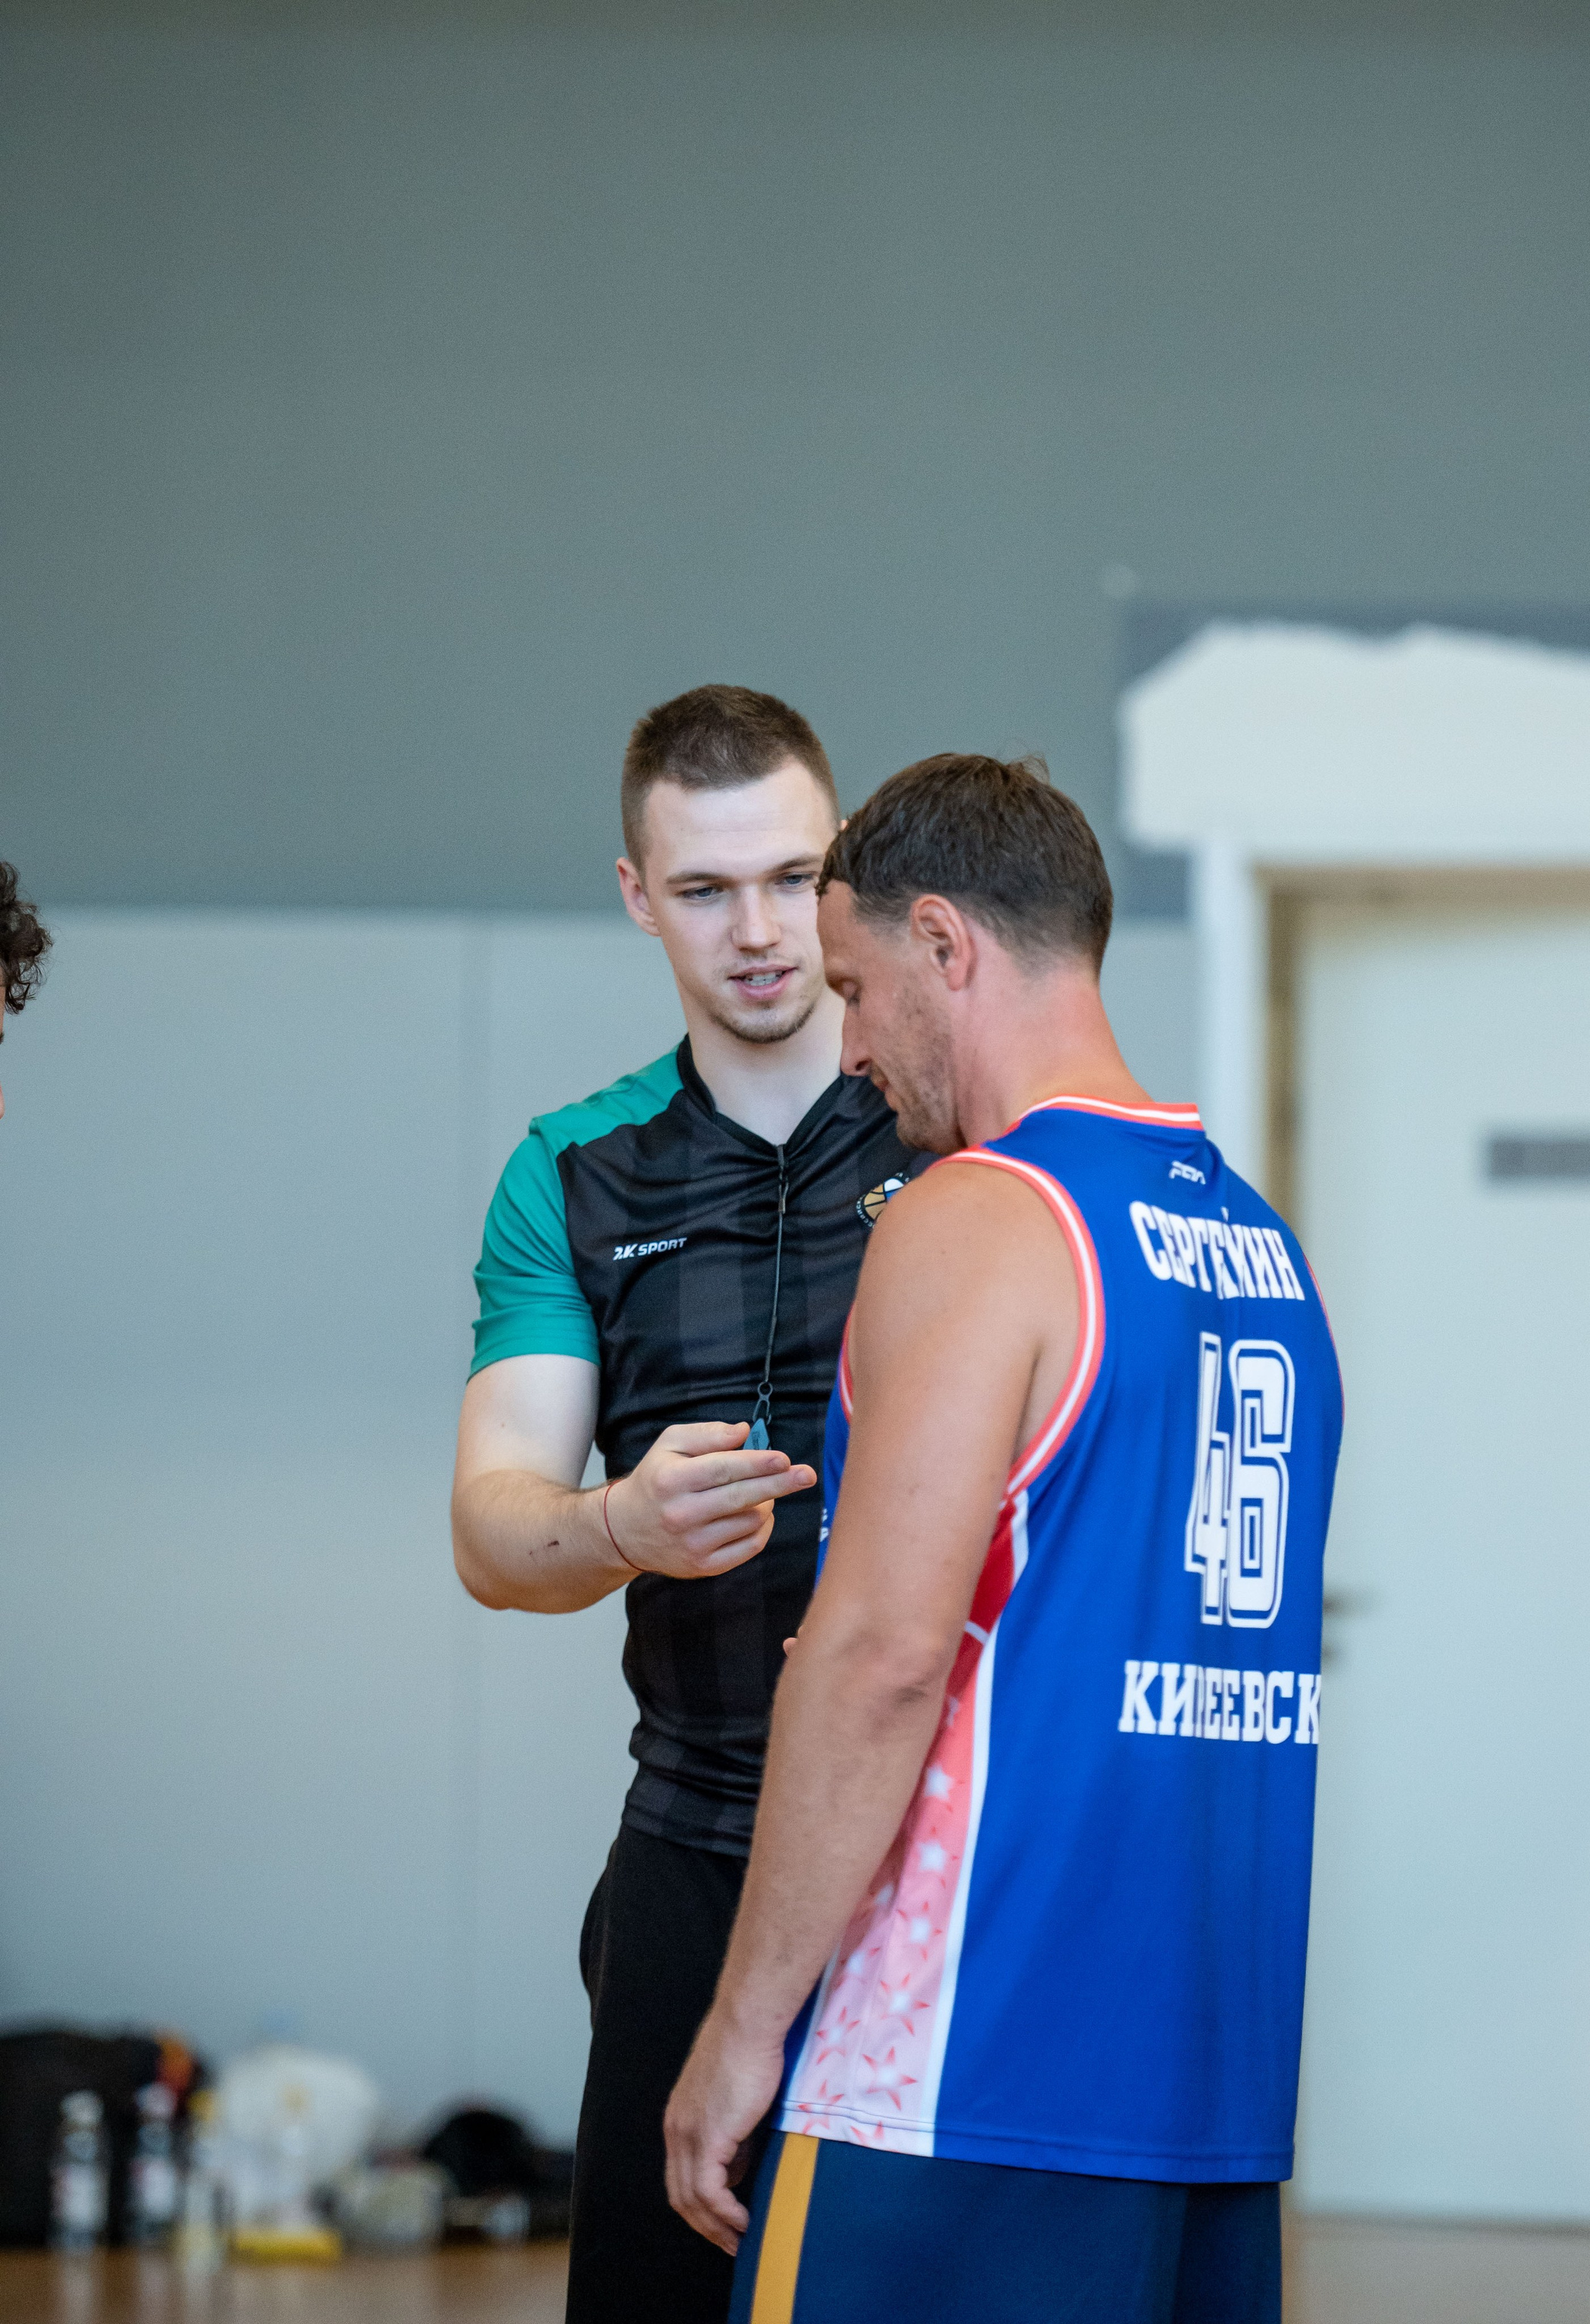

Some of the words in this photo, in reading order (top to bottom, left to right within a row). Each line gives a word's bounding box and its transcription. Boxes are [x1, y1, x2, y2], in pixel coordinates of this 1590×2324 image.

[612, 1243, 638, 1261] 2K
[637, 1237, 688, 1256] SPORT
[1184, 1331, 1296, 1629] 46
